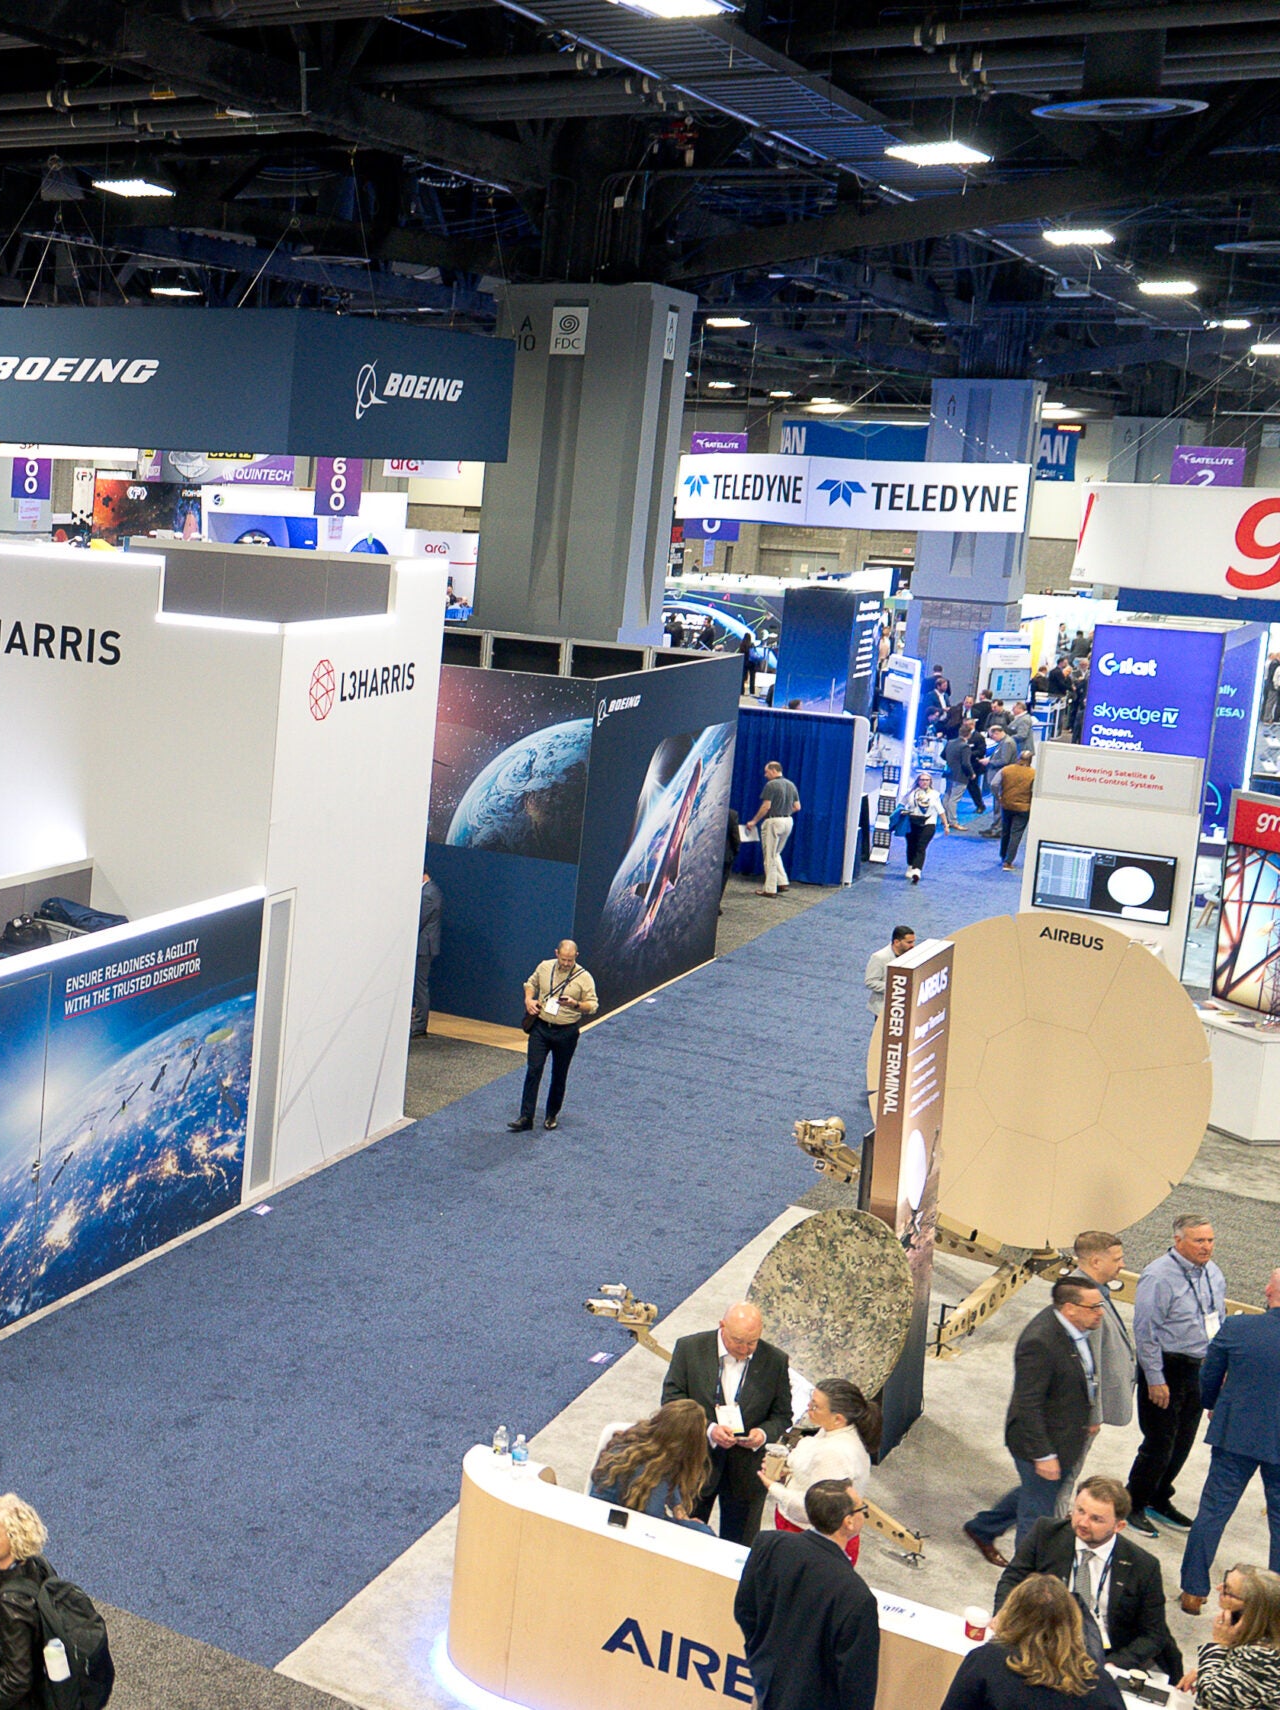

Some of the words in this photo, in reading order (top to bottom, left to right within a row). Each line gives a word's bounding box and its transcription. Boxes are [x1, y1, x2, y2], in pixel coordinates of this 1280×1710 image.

[521, 315, 533, 331] A
[554, 338, 583, 350] FDC
[384, 372, 464, 402] BOEING
[1190, 455, 1235, 466] SATELLITE
[235, 469, 293, 482] QUINTECH
[713, 474, 803, 504] TELEDYNE
[871, 482, 1019, 512] TELEDYNE
[339, 661, 416, 702] L3HARRIS
[608, 694, 641, 713] BOEING
[1092, 701, 1160, 725] skyedge
[1215, 706, 1245, 720] (ESA)
[1091, 723, 1133, 738] Chosen.
[1089, 737, 1144, 751] Deployed.
[1067, 773, 1097, 784] Mission
[1098, 777, 1128, 787] Control
[1129, 780, 1164, 791] Systems
[1075, 765, 1113, 777] Powering
[1114, 769, 1148, 780] Satellite
[1039, 926, 1105, 951] AIRBUS
[65, 968, 103, 994] ENSURE
[105, 951, 156, 979] READINESS
[156, 949, 164, 963] &
[164, 938, 199, 962] AGILITY
[64, 993, 91, 1015] WITH
[92, 986, 110, 1006] THE
[112, 972, 152, 1000] TRUSTED
[153, 957, 201, 985] DISRUPTOR
[888, 974, 907, 1036] RANGER
[882, 1042, 902, 1116] TERMINAL
[601, 1617, 756, 1704] AIRB
